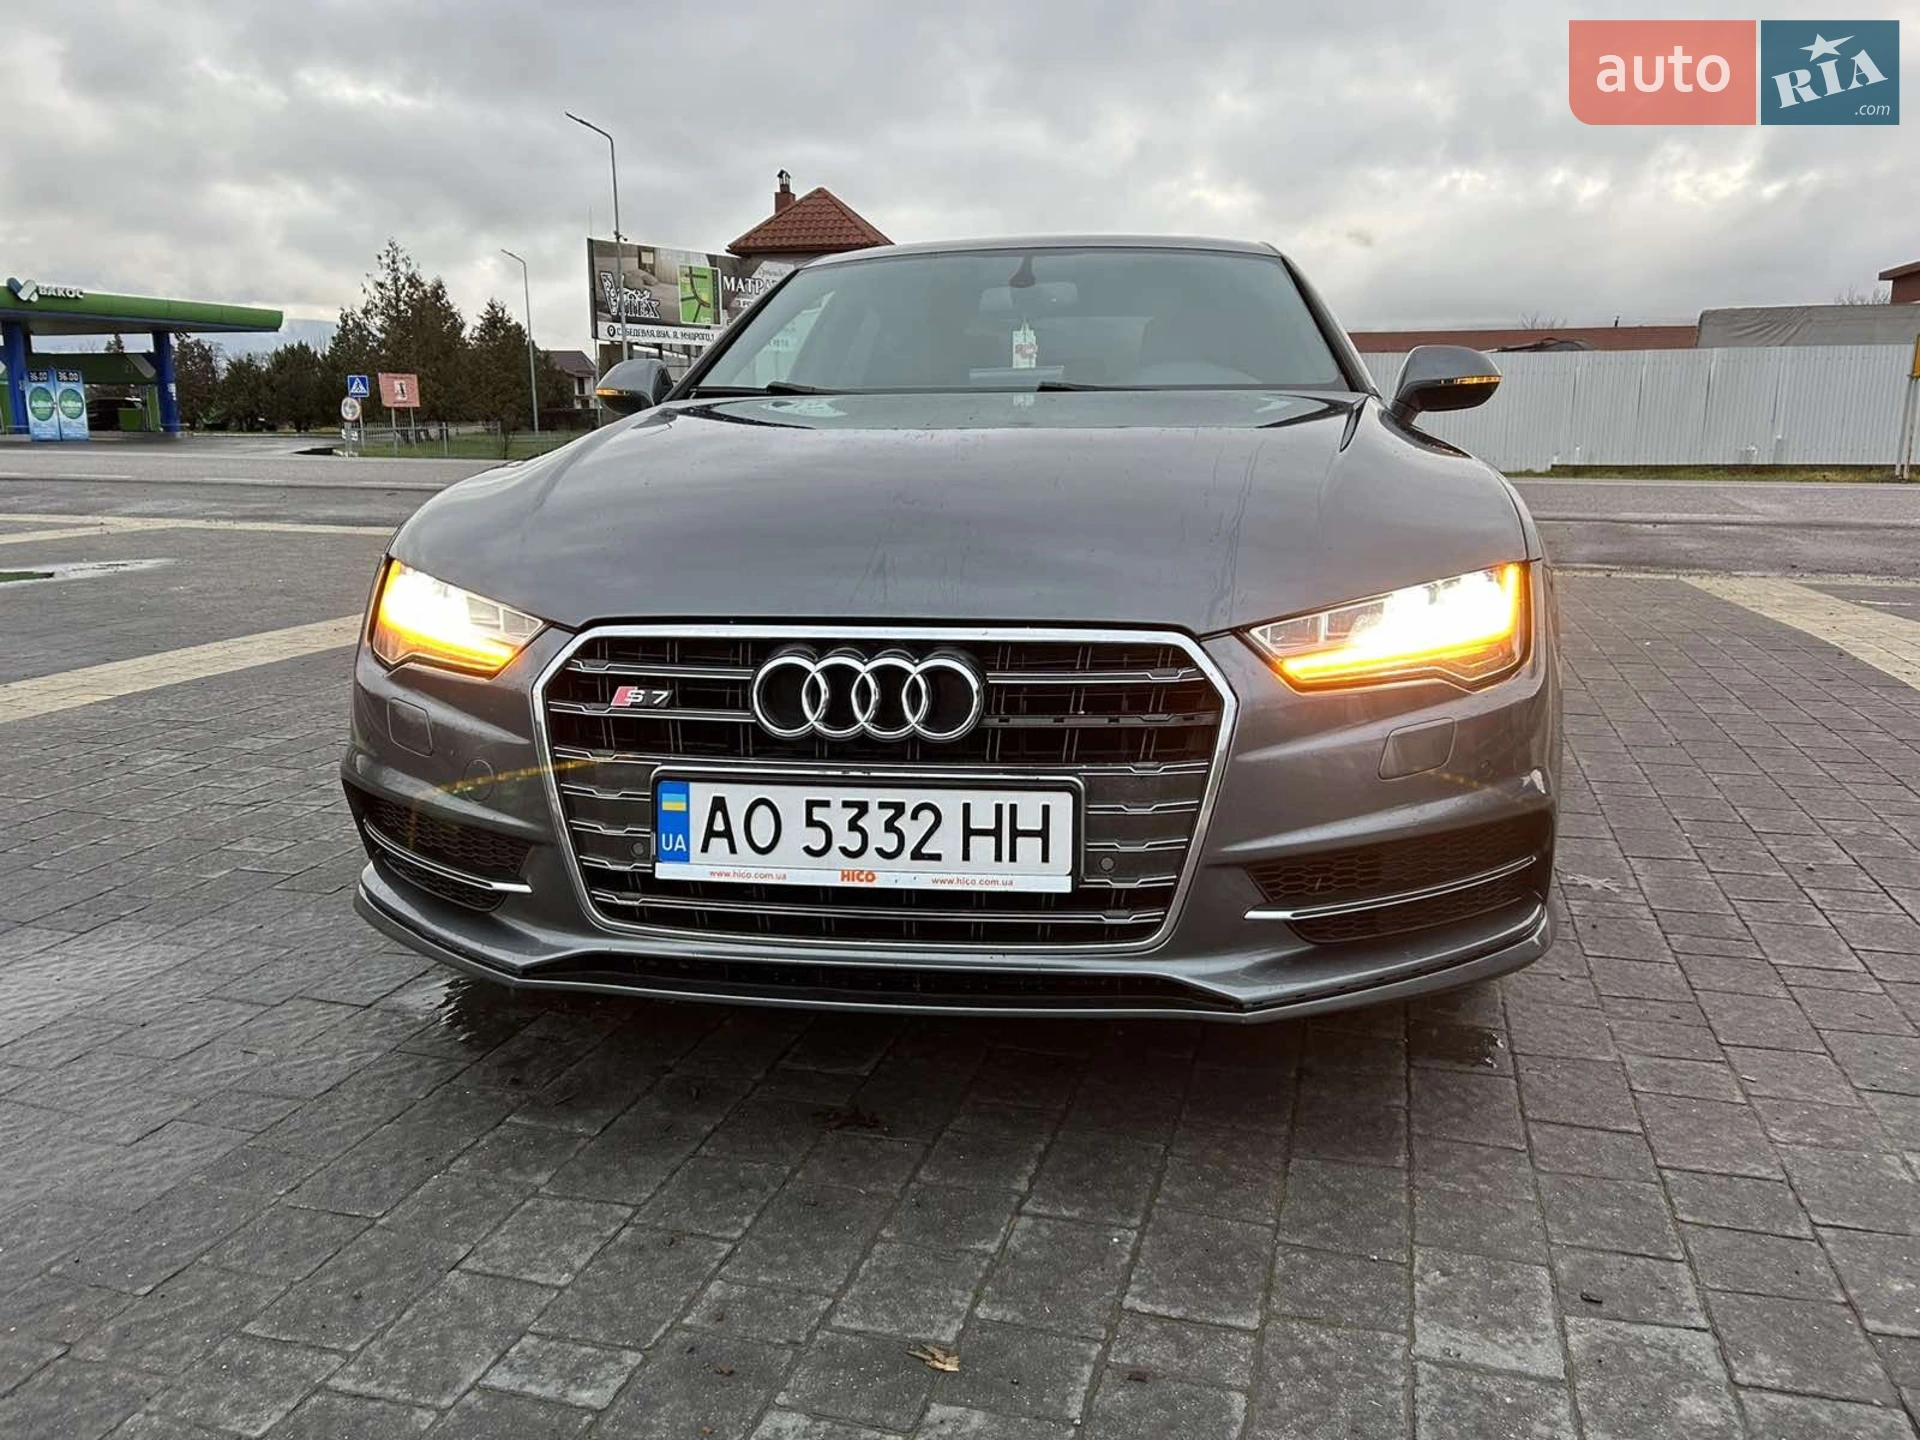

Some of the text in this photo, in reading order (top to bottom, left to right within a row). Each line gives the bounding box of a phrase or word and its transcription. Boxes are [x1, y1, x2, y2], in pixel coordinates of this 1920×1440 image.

[700, 795, 1051, 864] AO 5332 HH
[661, 833, 687, 852] UA
[709, 869, 1014, 887] www.hico.com.ua HICO www.hico.com.ua
